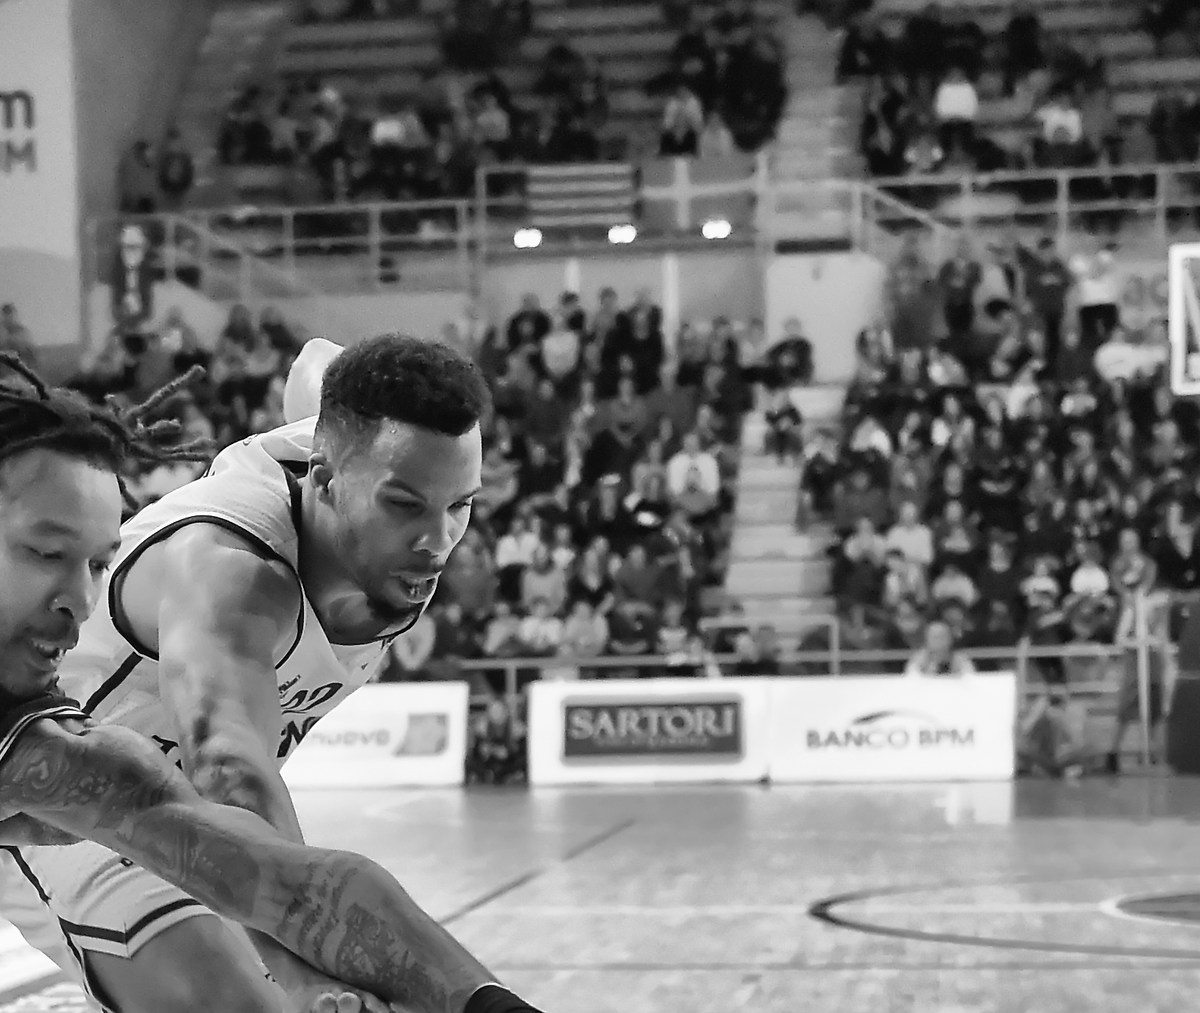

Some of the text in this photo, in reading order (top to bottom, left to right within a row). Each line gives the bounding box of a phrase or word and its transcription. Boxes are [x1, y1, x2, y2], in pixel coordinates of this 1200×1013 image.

[568, 706, 736, 740] SARTORI
[806, 728, 975, 750] BANCO BPM
